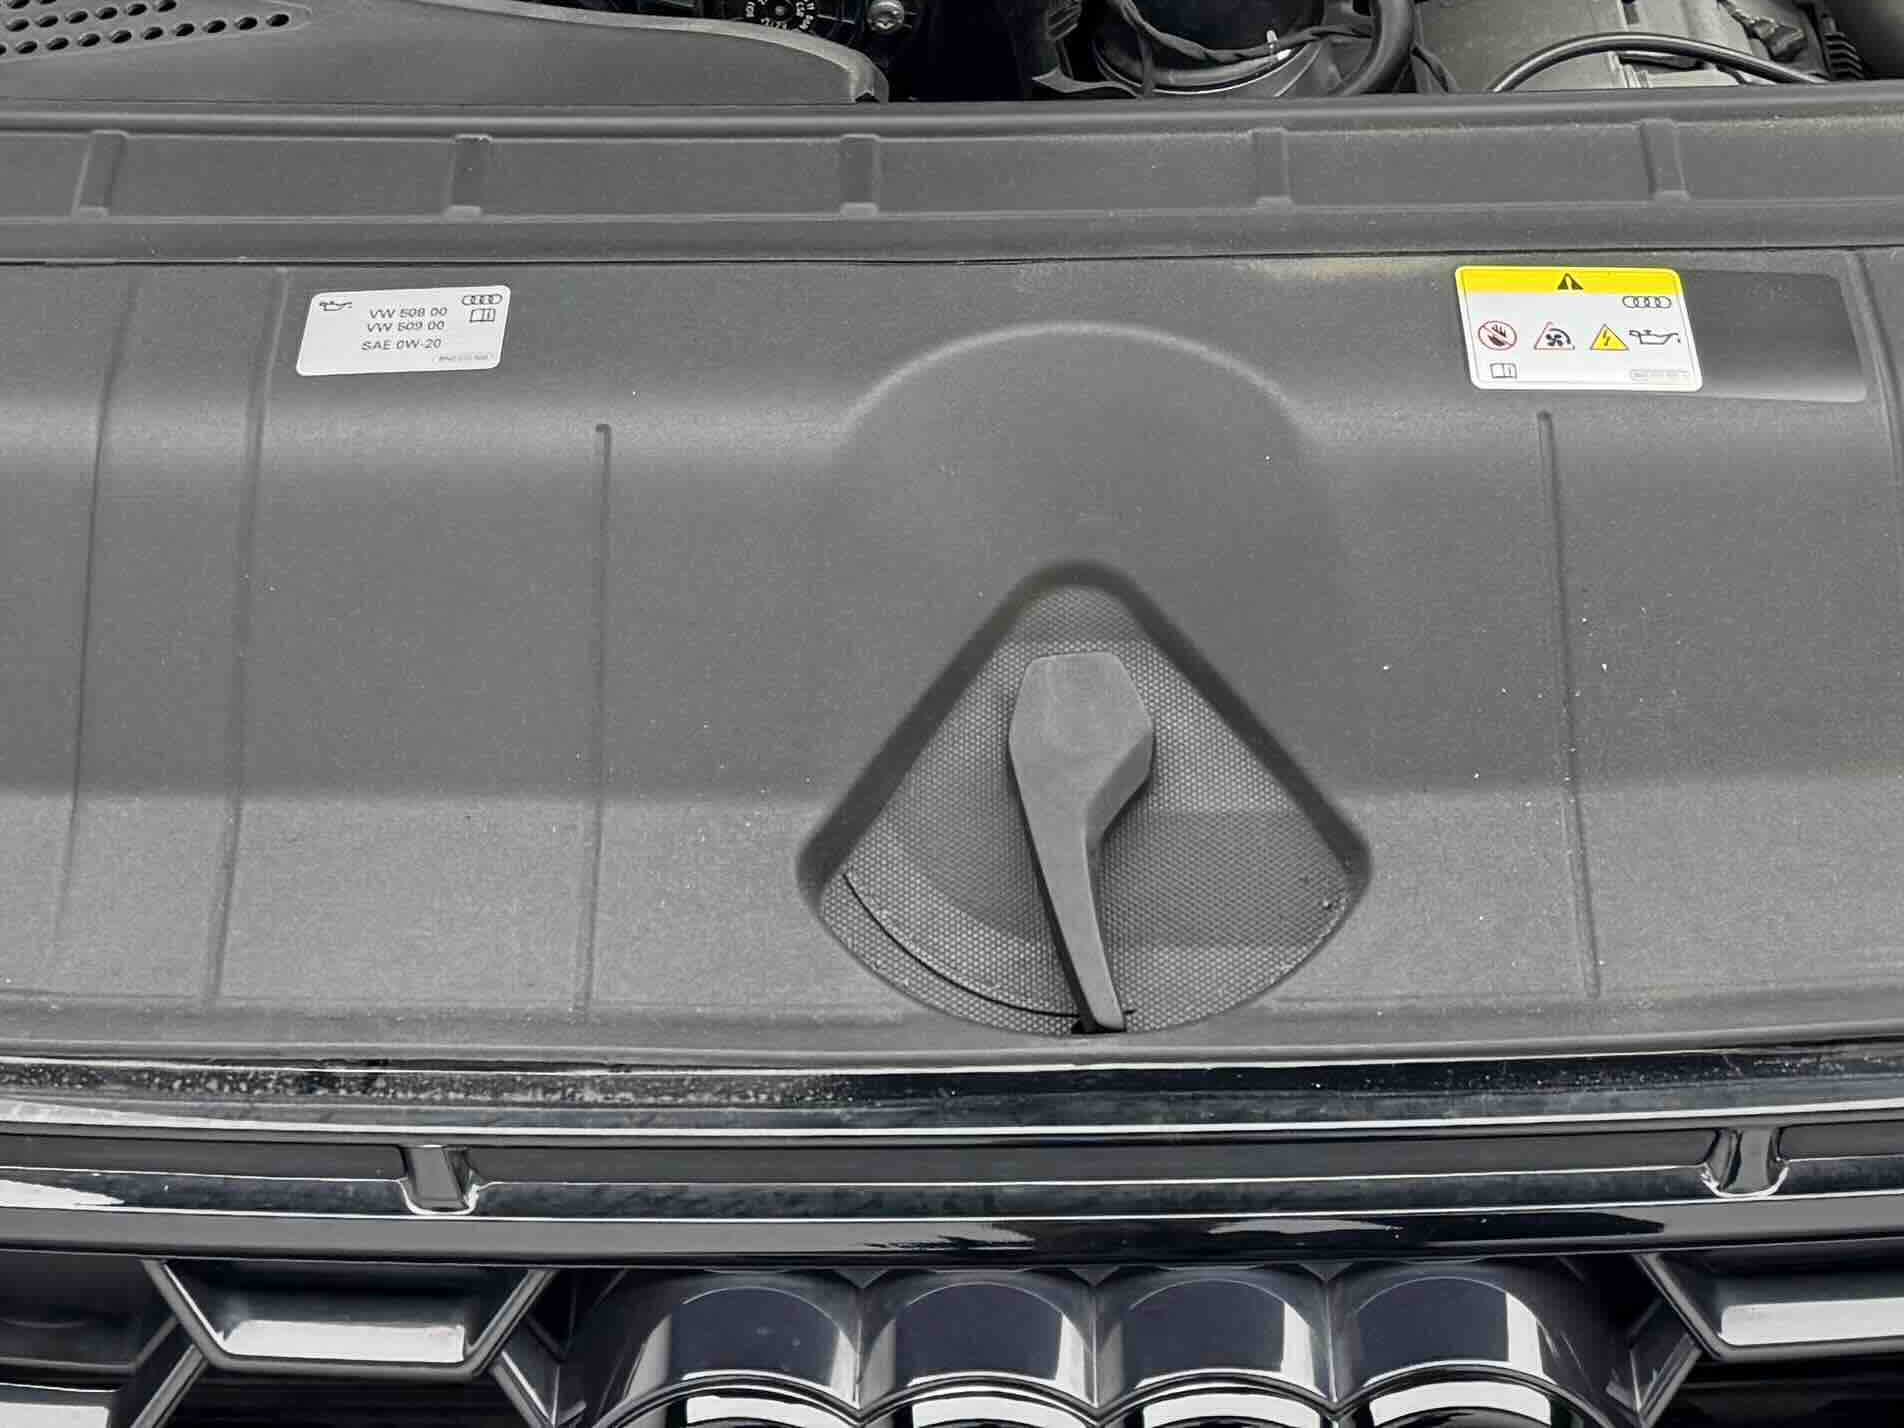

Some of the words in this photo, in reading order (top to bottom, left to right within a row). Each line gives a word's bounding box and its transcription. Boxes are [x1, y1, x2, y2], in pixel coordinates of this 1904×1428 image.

[369, 309, 395, 319] VW
[399, 308, 425, 318] 508
[431, 307, 448, 317] 00
[367, 323, 393, 333] VW
[397, 321, 423, 331] 509
[427, 320, 445, 330] 00
[361, 340, 391, 351] SAE
[396, 338, 442, 349] 0W-20
